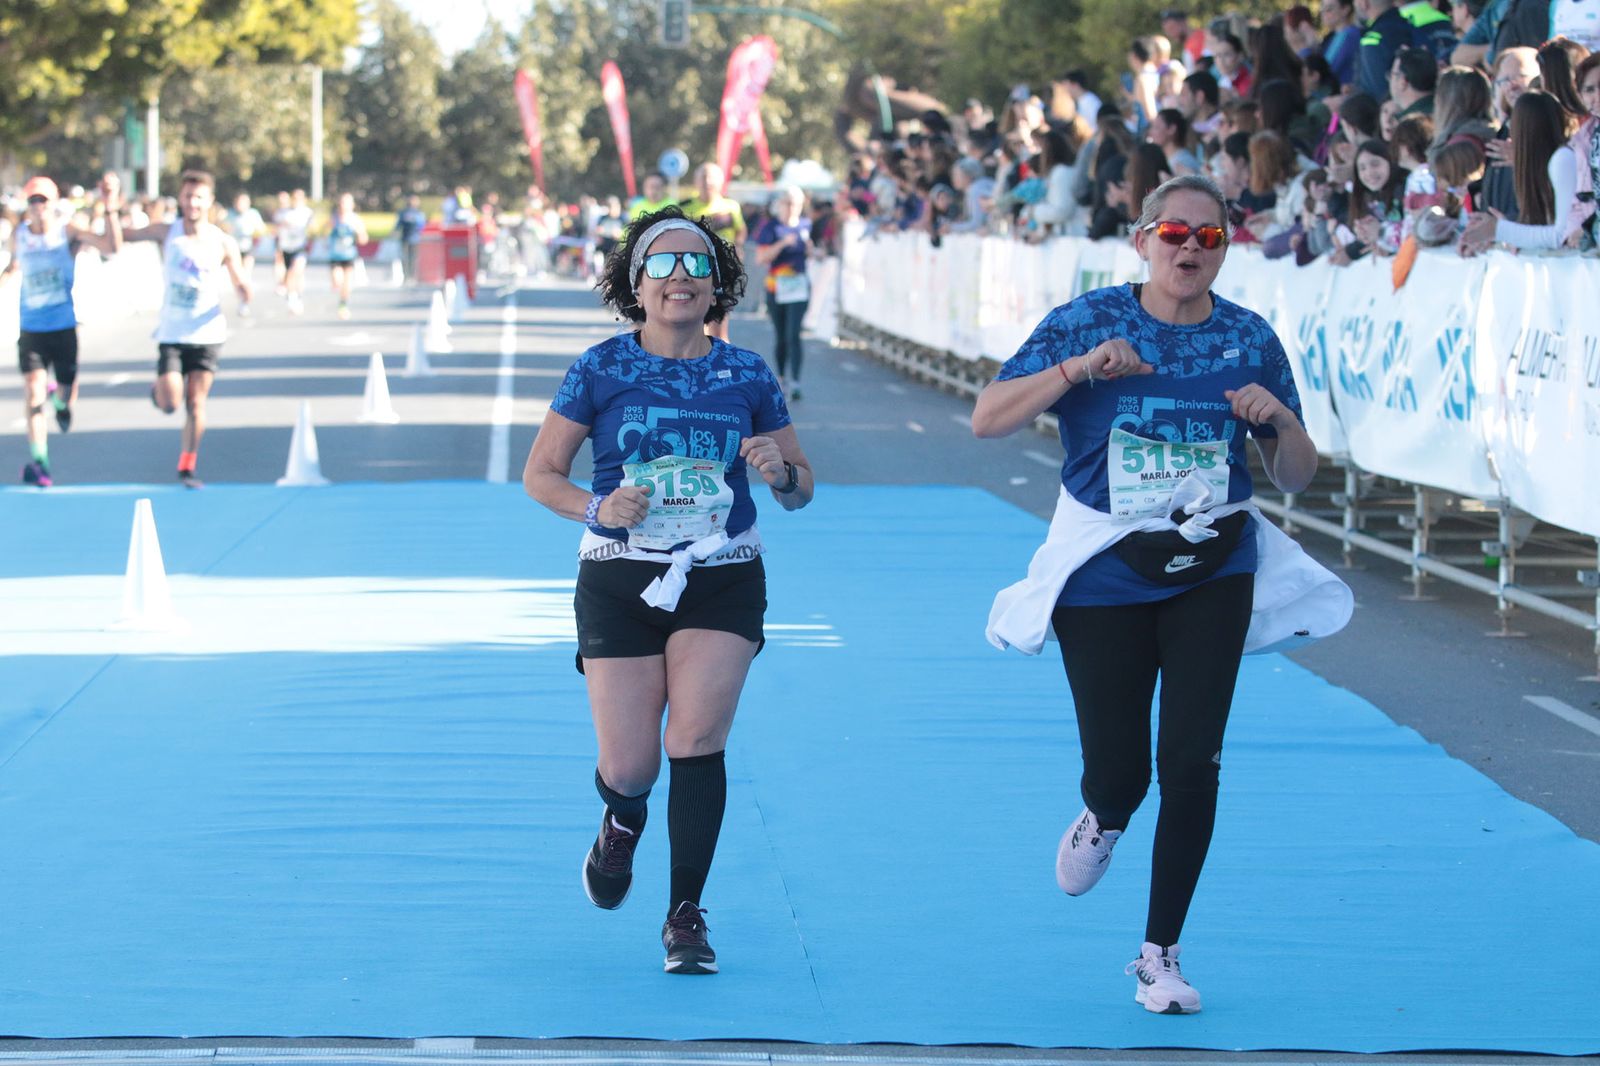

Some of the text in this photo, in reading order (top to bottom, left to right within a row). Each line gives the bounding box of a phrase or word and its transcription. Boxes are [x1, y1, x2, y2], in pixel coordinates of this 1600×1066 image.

[1118, 396, 1138, 404] 1995
[1176, 399, 1232, 411] Aniversar
[1117, 404, 1139, 413] 2020
[623, 413, 644, 421] 2020
[680, 409, 740, 424] Aniversario
[1122, 444, 1217, 474] 5158
[1140, 470, 1172, 481] MARÍA
[634, 468, 720, 498] 5159
[662, 498, 696, 506] MARGA
[1170, 555, 1196, 566] NIKE
